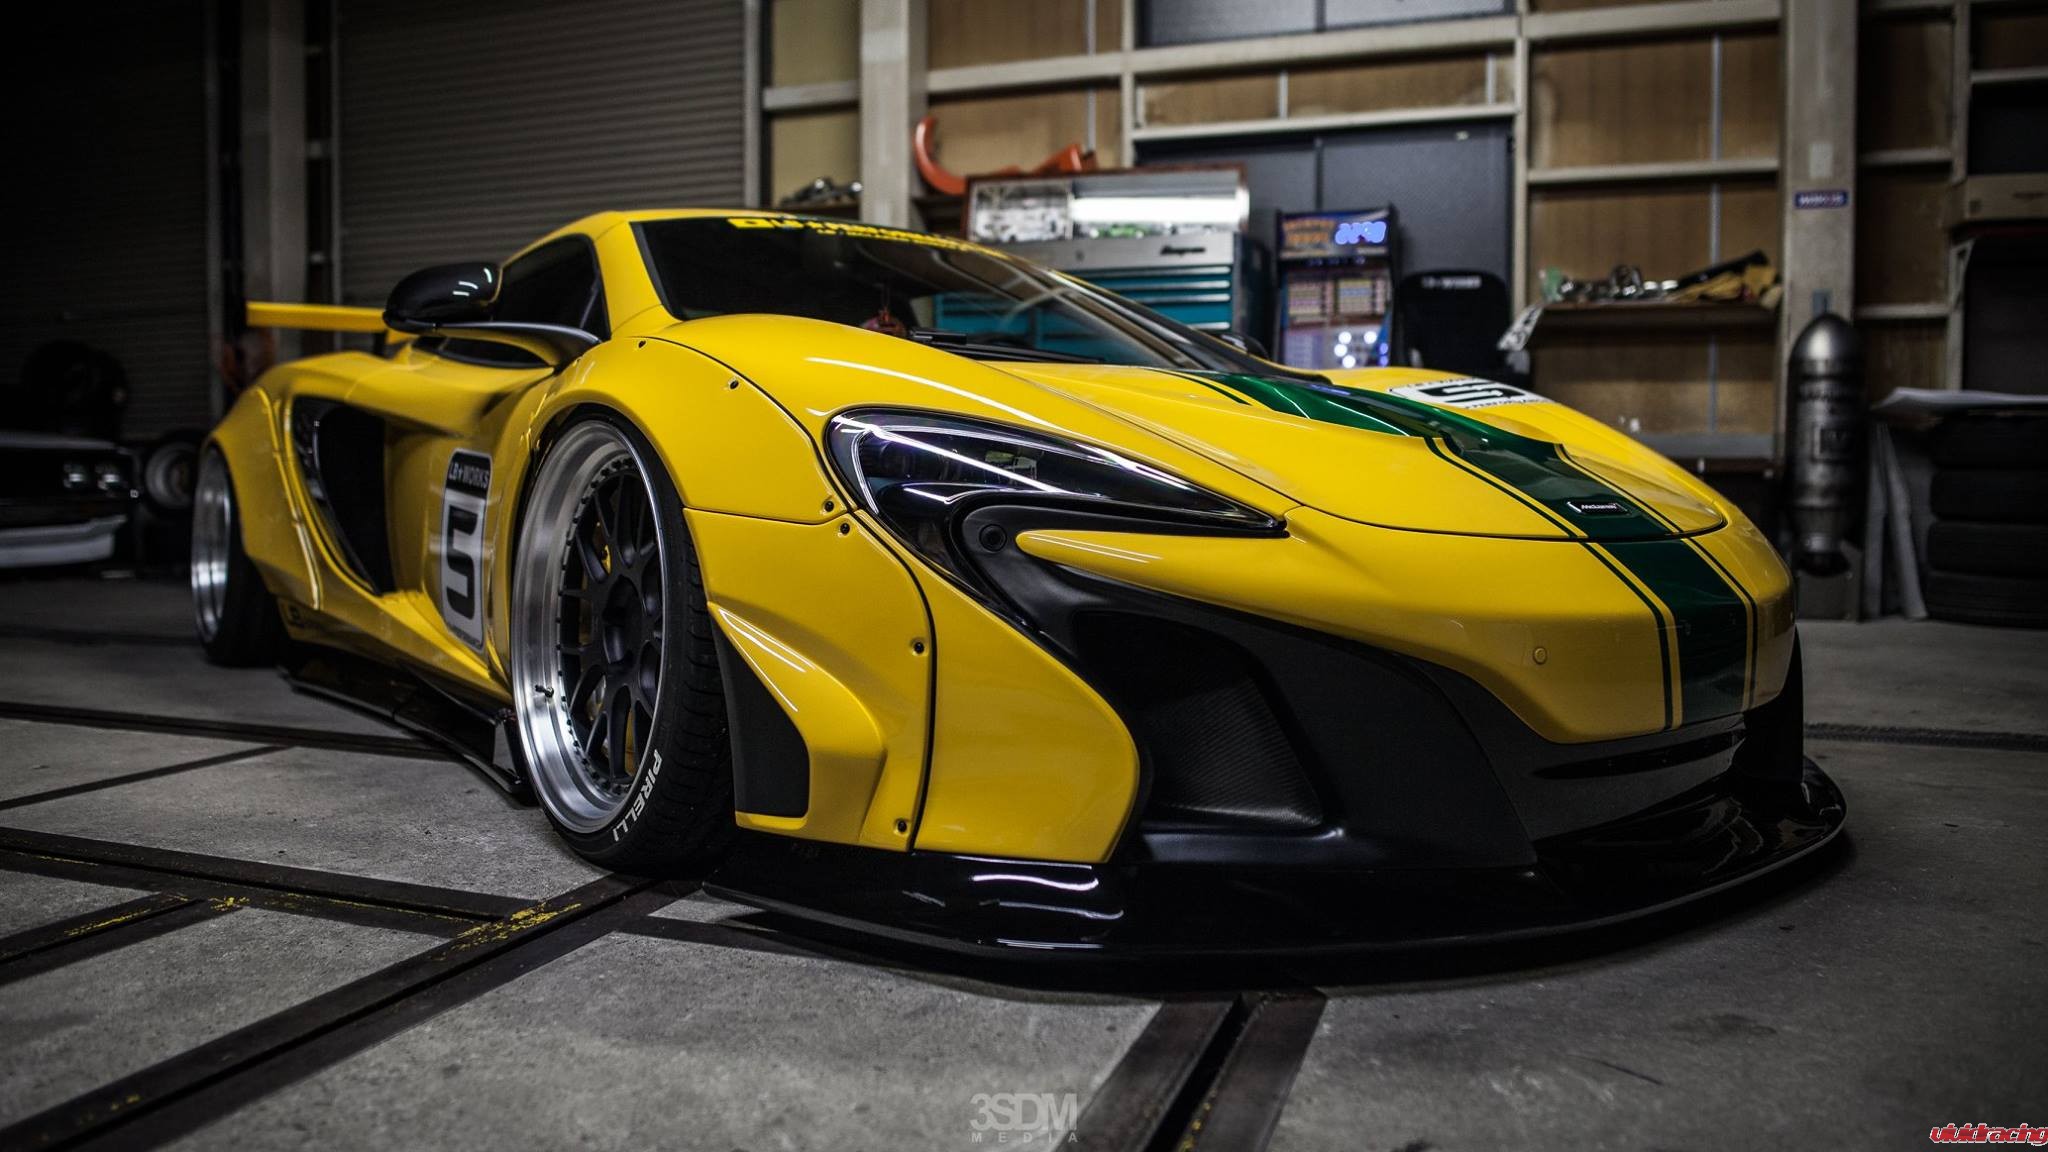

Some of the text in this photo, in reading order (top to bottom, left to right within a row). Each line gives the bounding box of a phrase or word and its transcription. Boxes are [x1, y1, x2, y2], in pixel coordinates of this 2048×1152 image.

[1418, 380, 1525, 403] 5
[446, 505, 478, 620] 5
[612, 749, 663, 842] PIRELLI
